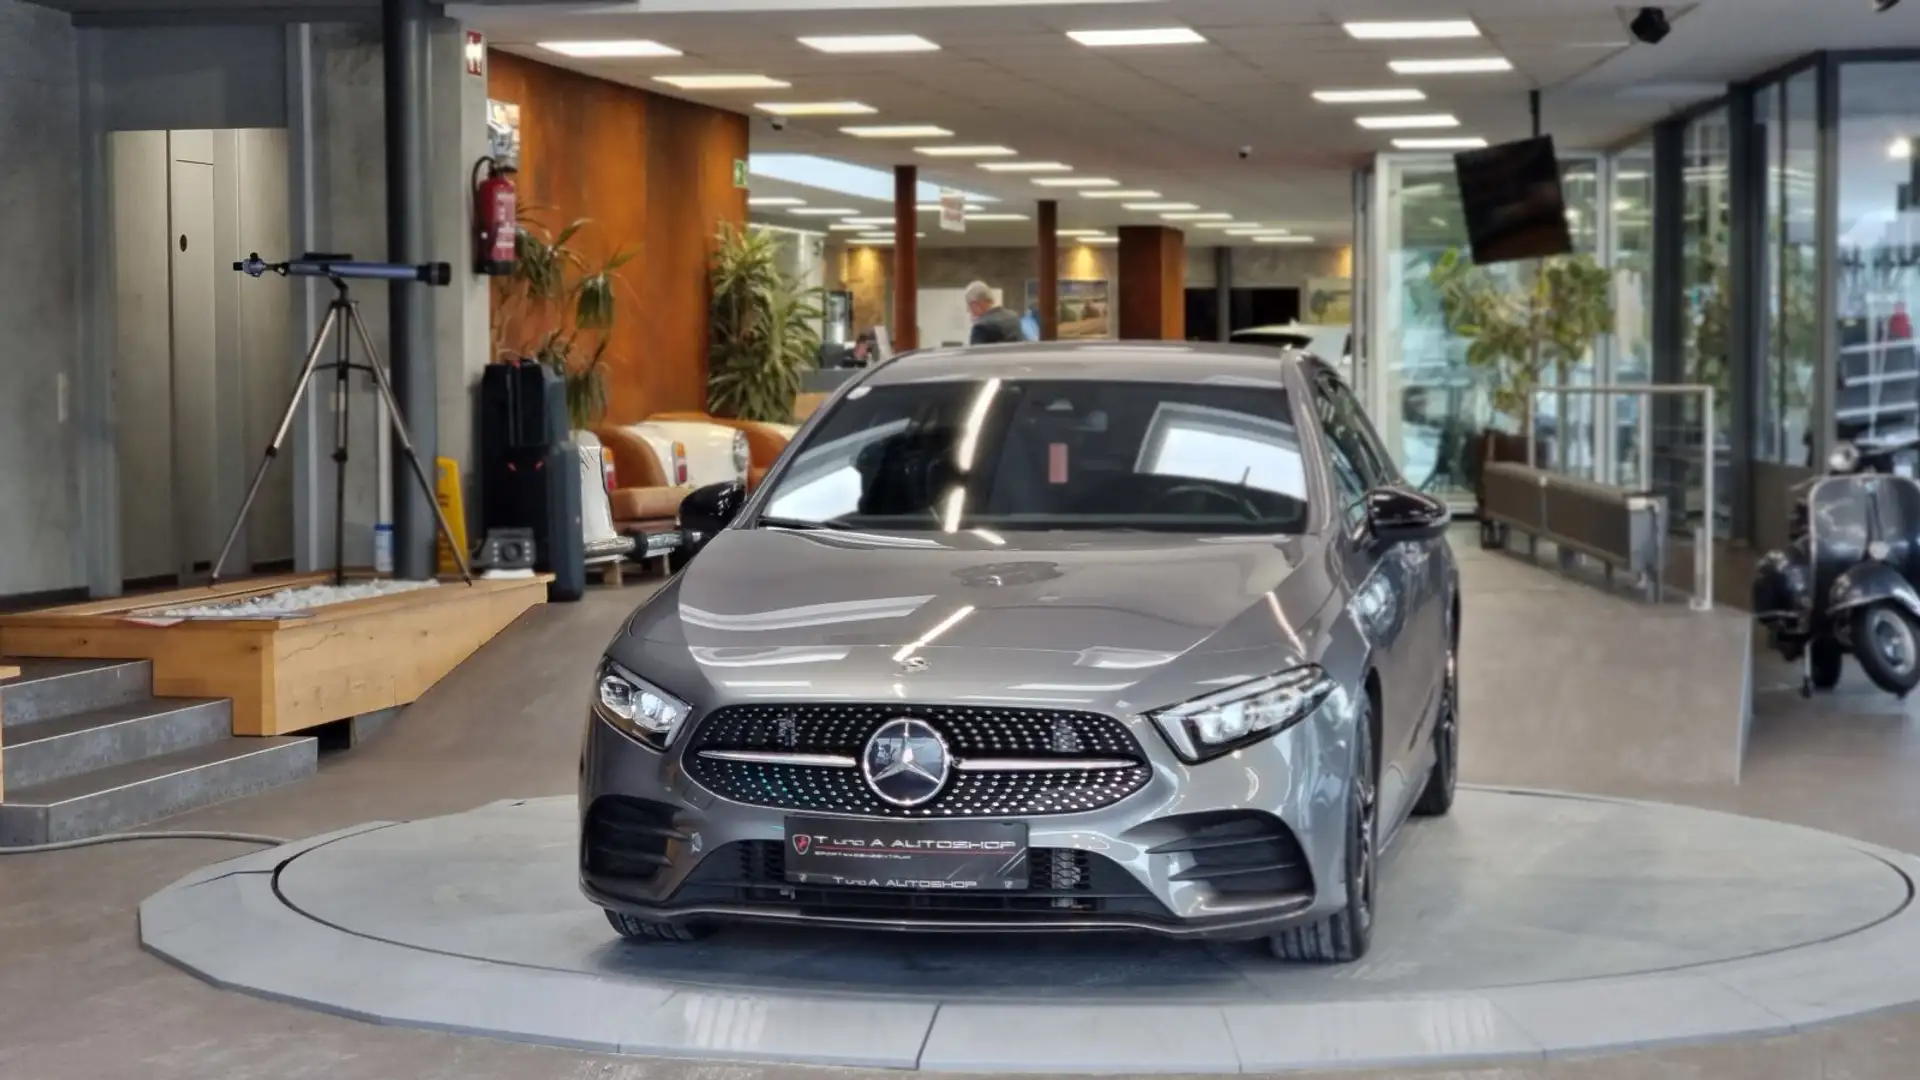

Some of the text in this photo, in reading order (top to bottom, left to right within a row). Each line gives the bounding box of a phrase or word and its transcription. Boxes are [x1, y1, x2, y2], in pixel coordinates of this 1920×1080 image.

[870, 838, 885, 847] A
[891, 839, 1016, 849] AUTOSHOP
[885, 879, 978, 888] AUTOSHOP
